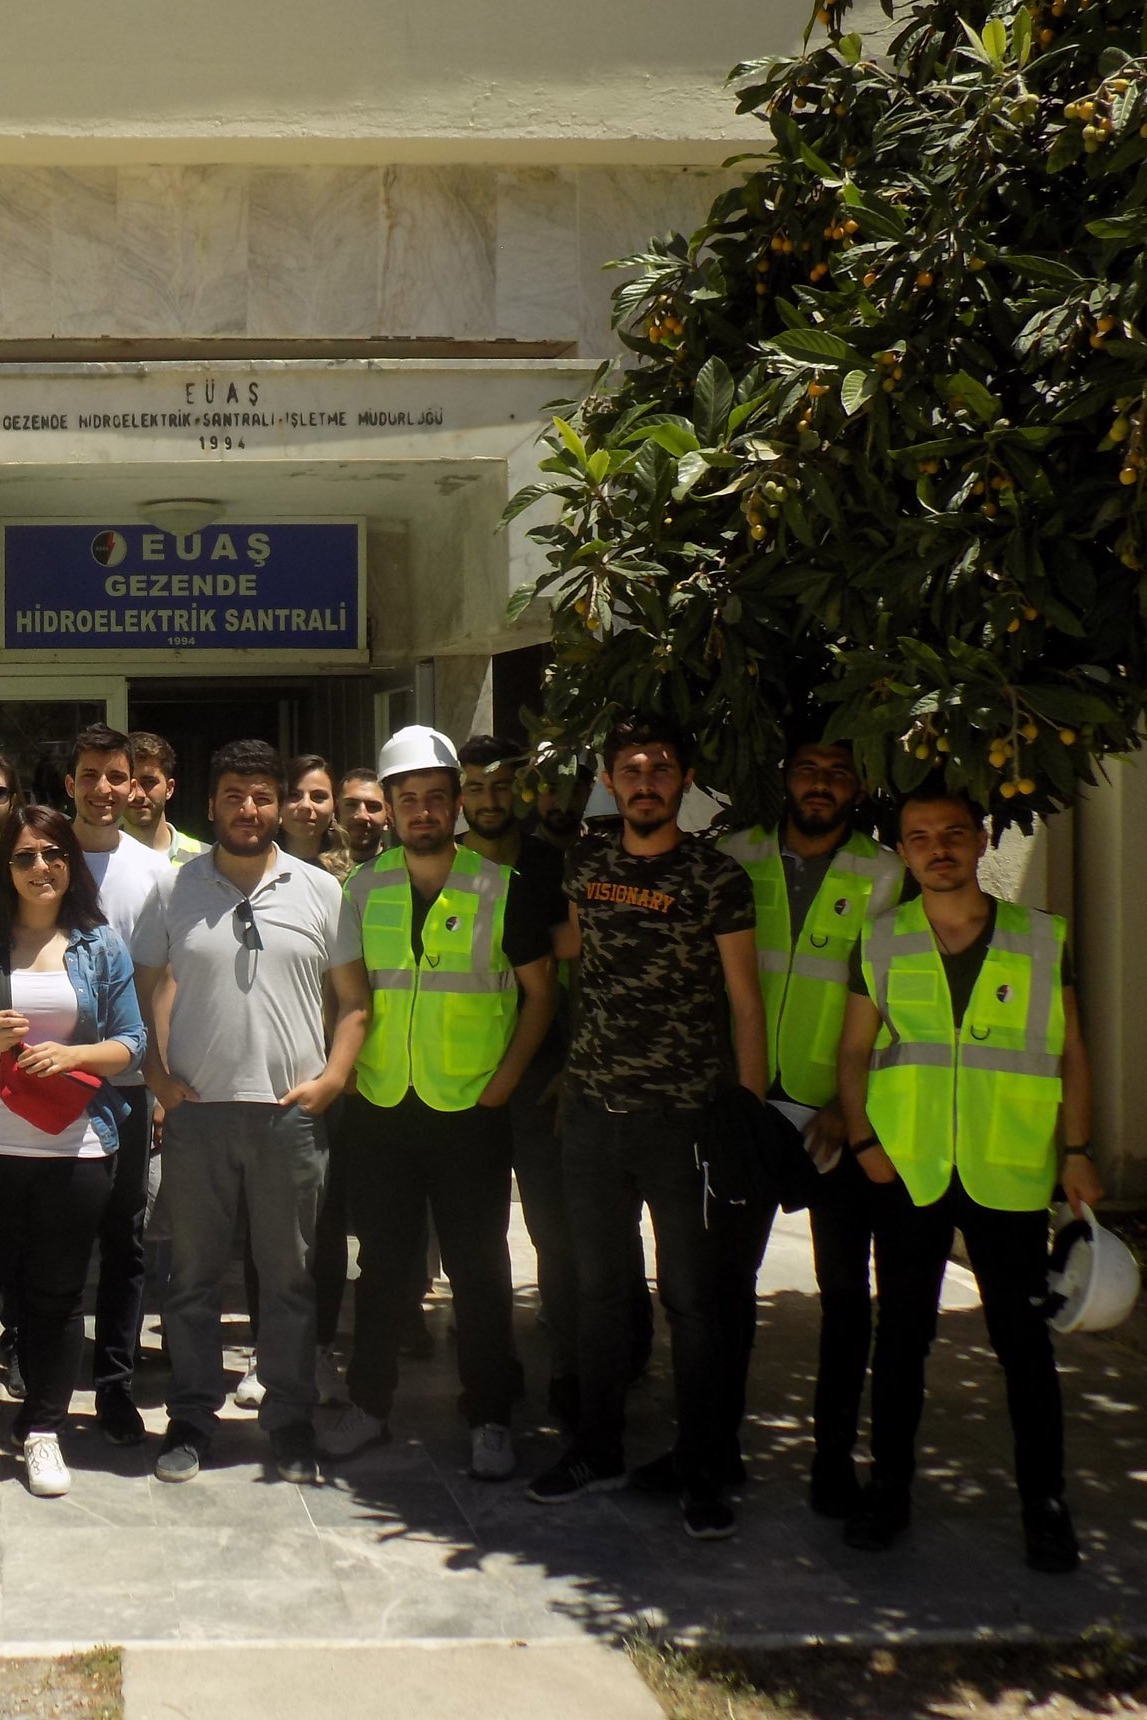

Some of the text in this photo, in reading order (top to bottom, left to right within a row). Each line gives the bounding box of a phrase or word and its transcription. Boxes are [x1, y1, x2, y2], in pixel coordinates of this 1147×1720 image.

[185, 378, 260, 407] EÜAŞ
[2, 413, 68, 430] GEZENDE
[199, 435, 246, 450] 1994
[105, 574, 258, 597] GEZENDE
[16, 601, 347, 633] HİDROELEKTRİK SANTRALİ
[167, 637, 196, 646] 1994
[585, 882, 675, 913] VISIONARY
